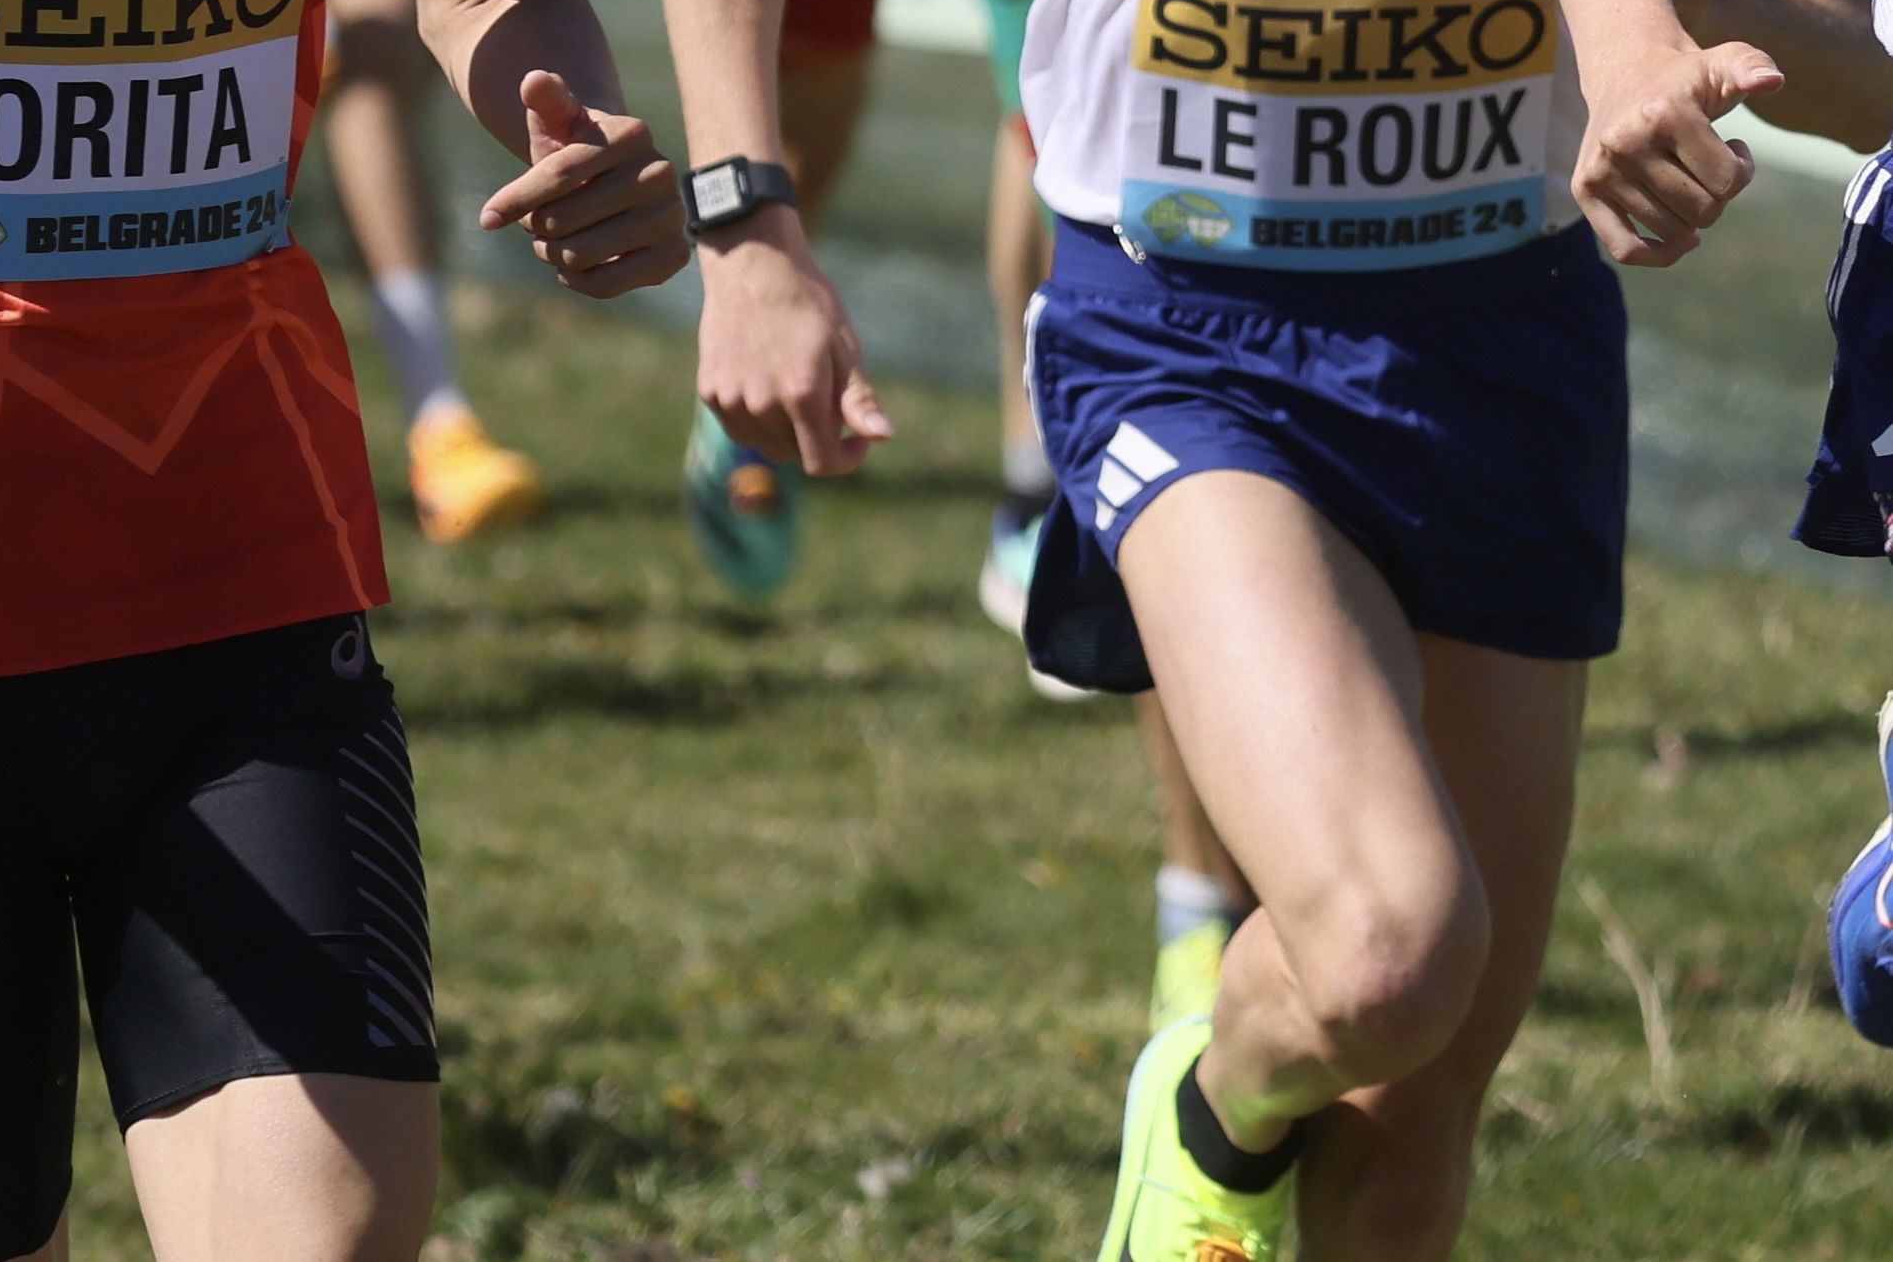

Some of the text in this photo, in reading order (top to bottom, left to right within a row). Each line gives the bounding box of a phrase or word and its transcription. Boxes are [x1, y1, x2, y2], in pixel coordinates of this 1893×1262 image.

[1158, 87, 1528, 187] LE ROUX
[26, 188, 277, 254] BELGRADE 24
[1251, 206, 1465, 250] BELGRADE
[1472, 198, 1527, 235] 24
